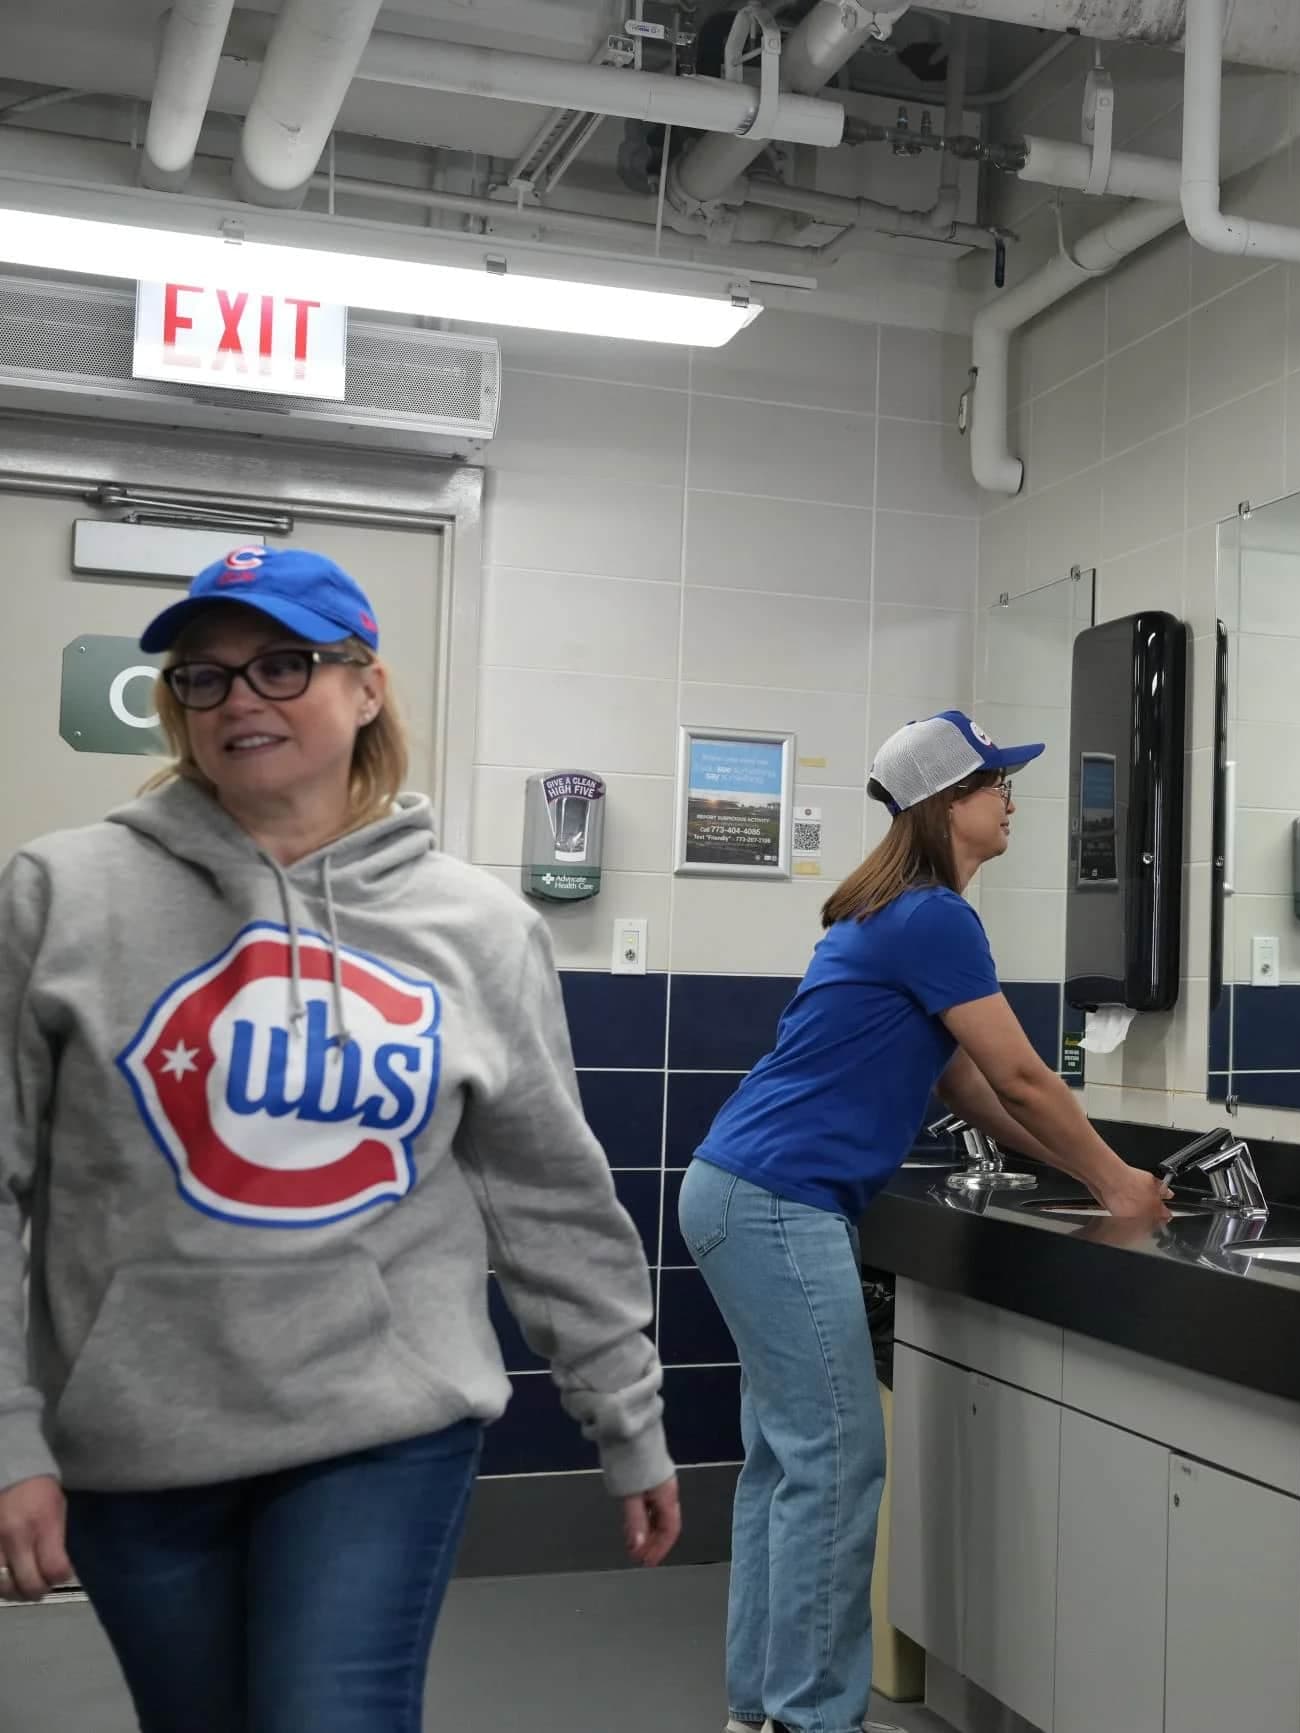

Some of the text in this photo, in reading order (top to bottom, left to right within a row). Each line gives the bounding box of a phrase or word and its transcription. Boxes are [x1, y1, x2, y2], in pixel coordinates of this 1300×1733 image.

[162, 282, 321, 380] EXIT
[546, 776, 597, 789] GIVE A CLEAN
[548, 784, 595, 798] HIGH FIVE
[555, 873, 587, 883] Advocate
[554, 880, 595, 890] Health Care
